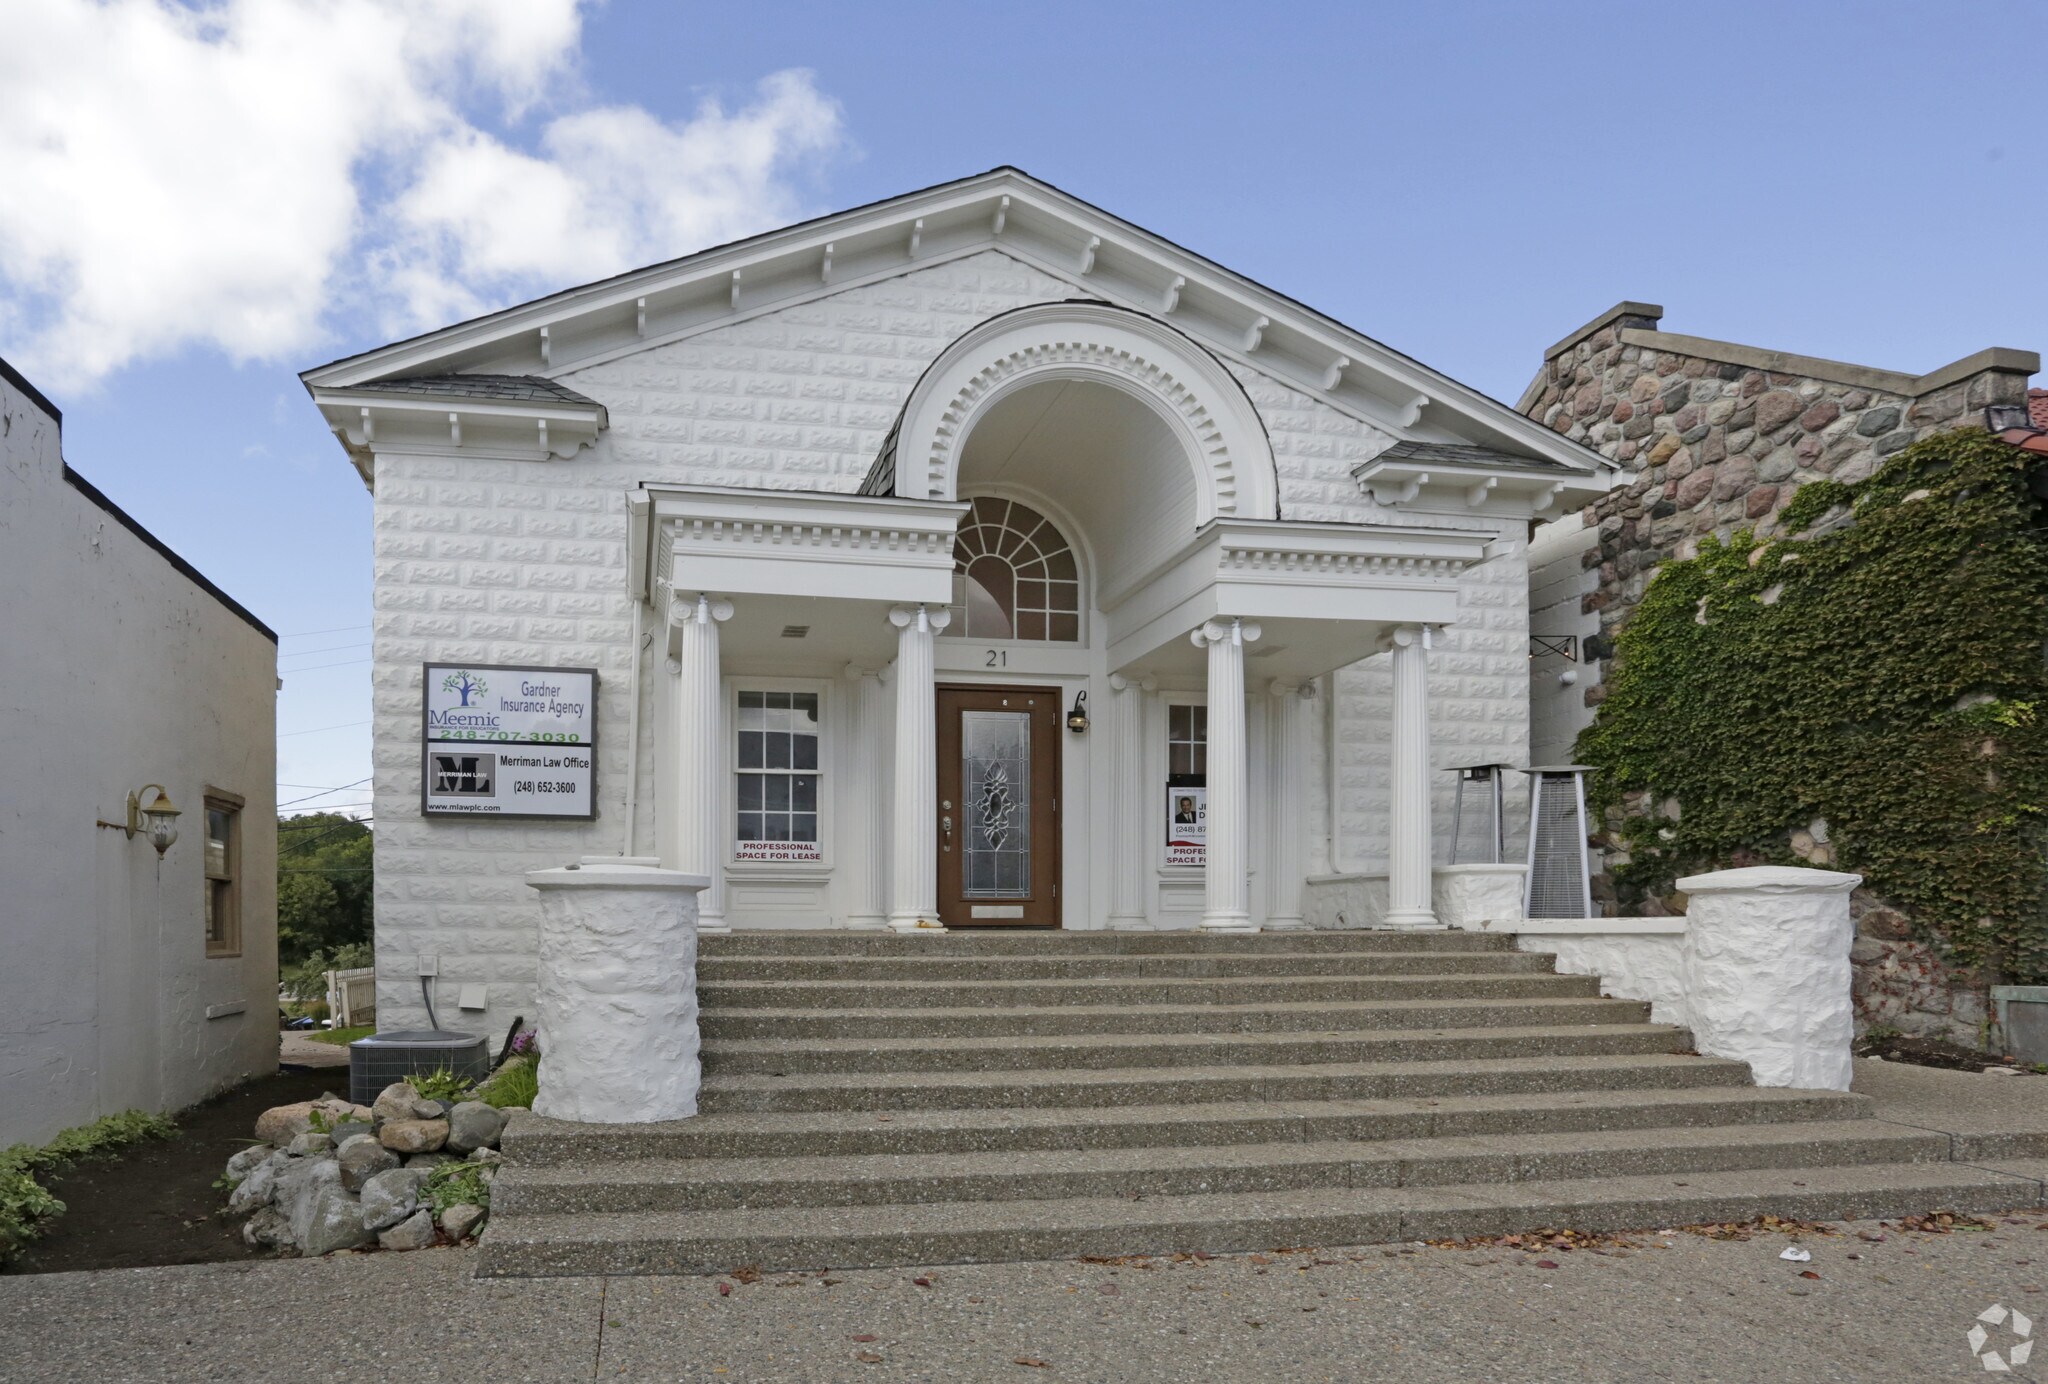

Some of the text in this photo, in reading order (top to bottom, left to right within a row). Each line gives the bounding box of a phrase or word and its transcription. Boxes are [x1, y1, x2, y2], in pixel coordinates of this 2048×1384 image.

[986, 649, 1006, 667] 21
[521, 681, 561, 698] Gardner
[500, 697, 584, 719] Insurance Agency
[429, 709, 500, 727] Meemic
[440, 730, 580, 742] 248-707-3030
[500, 755, 589, 769] Merriman Law Office
[514, 781, 576, 795] (248) 652-3600
[427, 804, 501, 812] www.mlawplc.com
[1176, 826, 1195, 834] (248)
